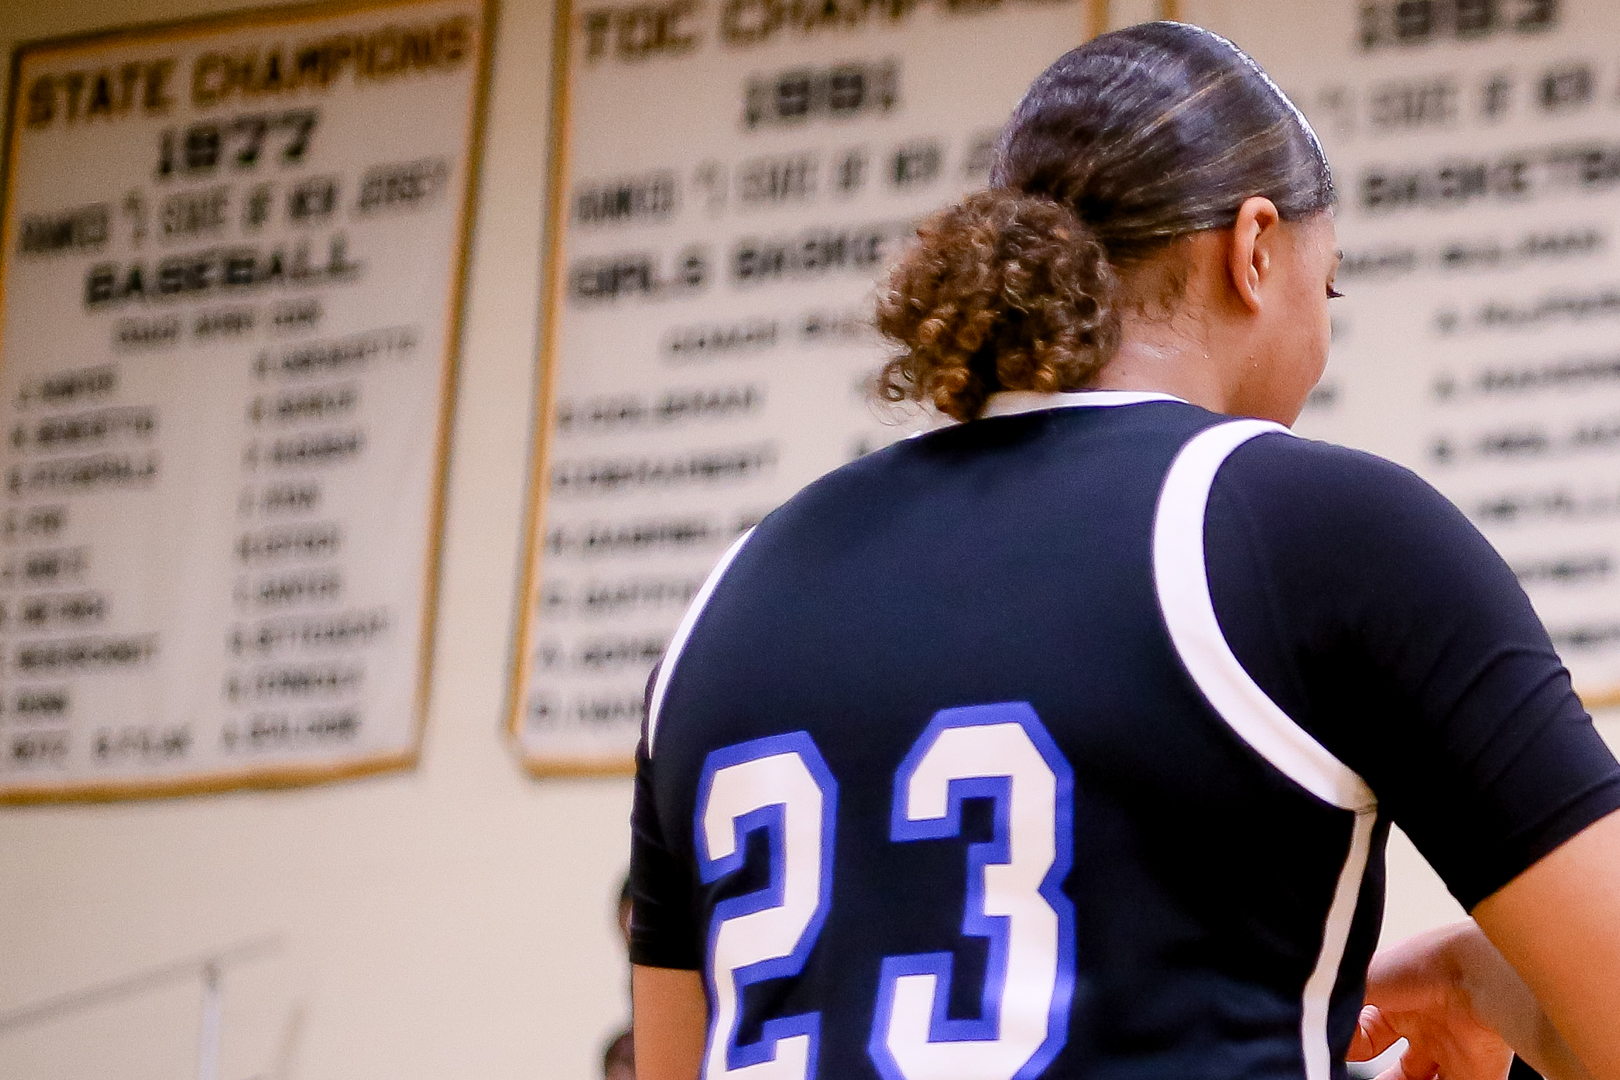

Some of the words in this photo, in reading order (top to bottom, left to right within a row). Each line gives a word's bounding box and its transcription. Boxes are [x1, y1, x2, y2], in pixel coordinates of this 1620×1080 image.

[26, 60, 178, 126] STATE
[190, 20, 470, 104] CHAMPIONS
[86, 237, 360, 306] BASEBALL
